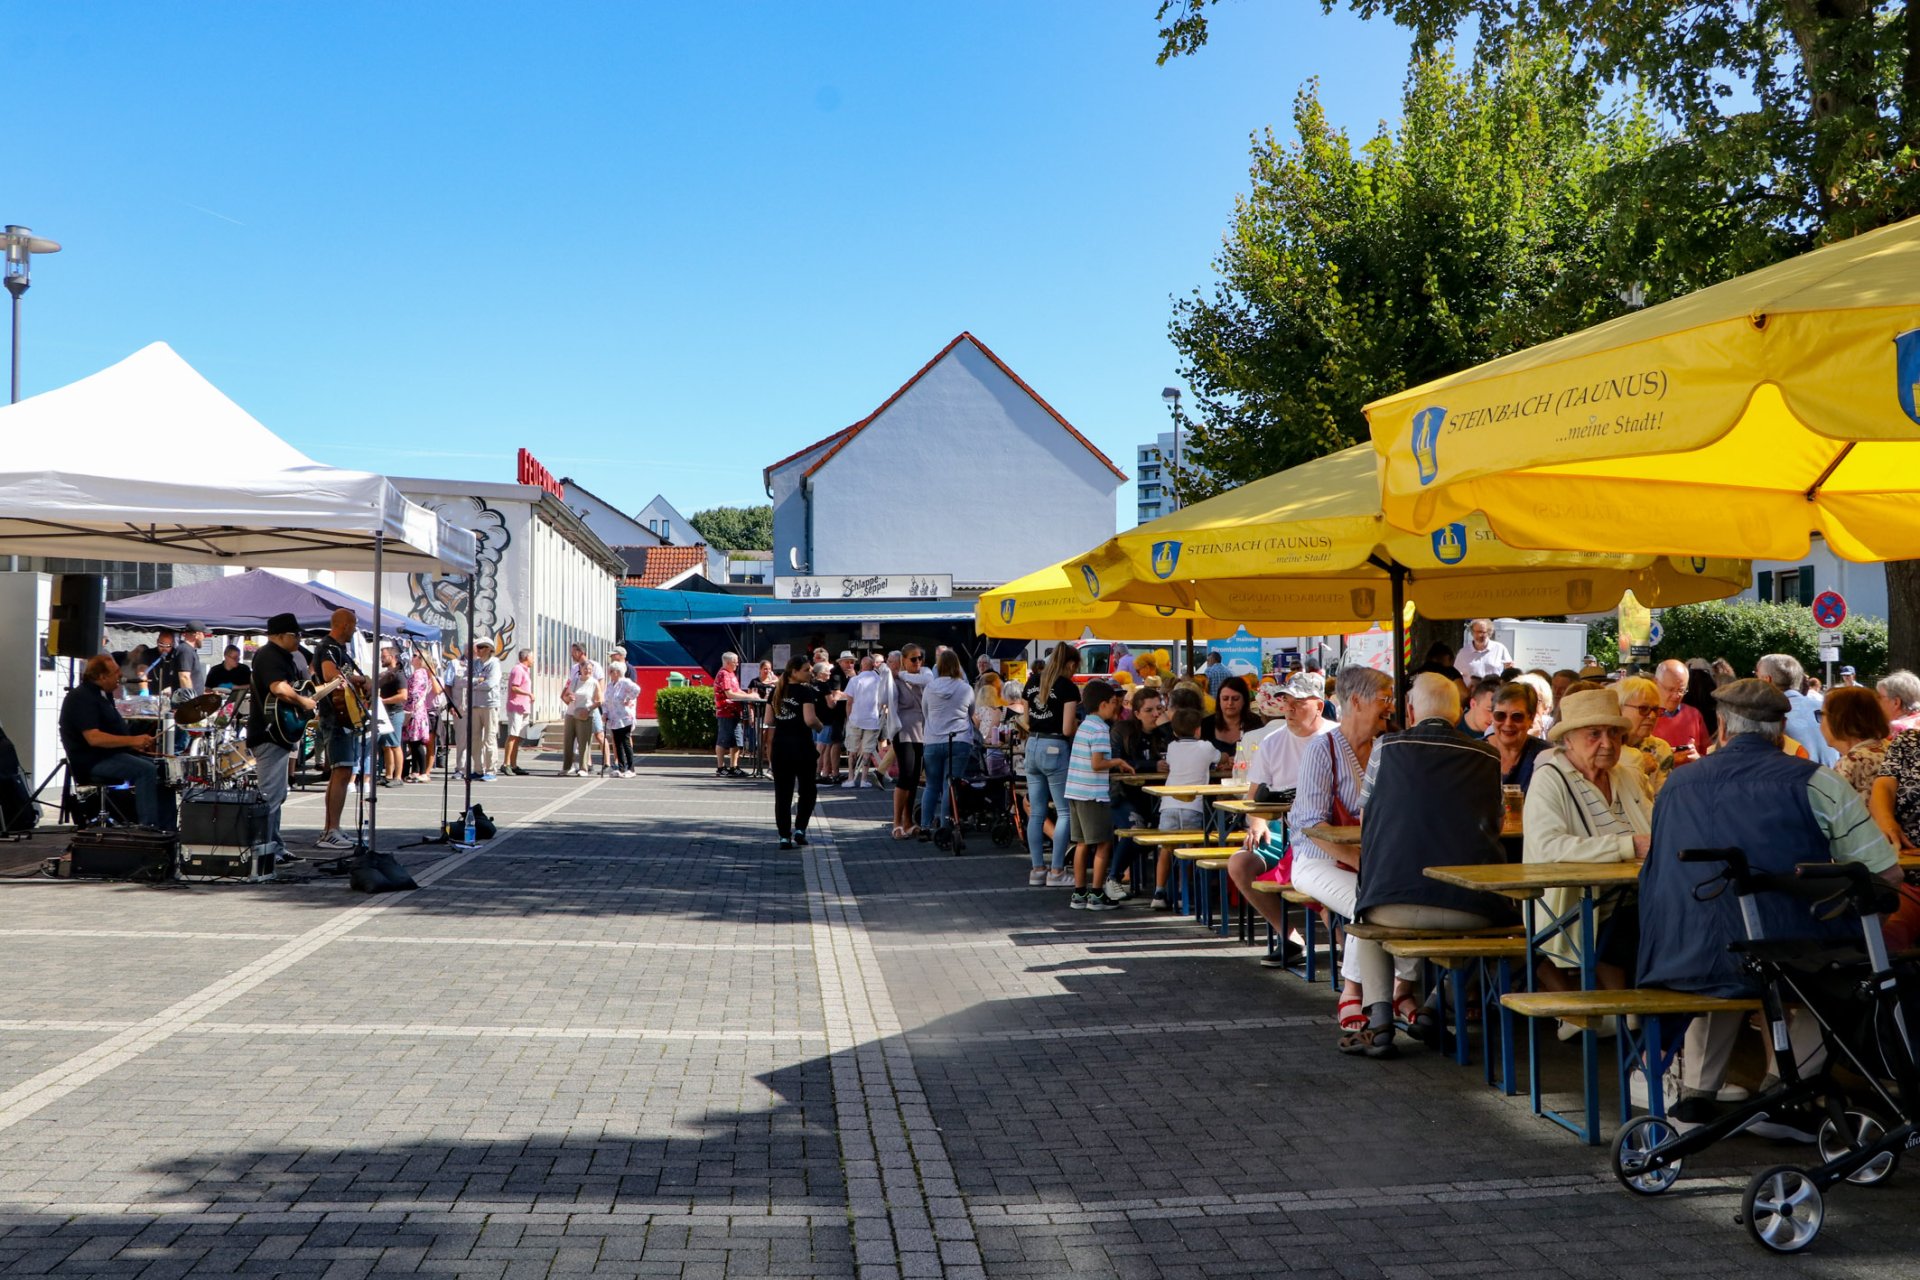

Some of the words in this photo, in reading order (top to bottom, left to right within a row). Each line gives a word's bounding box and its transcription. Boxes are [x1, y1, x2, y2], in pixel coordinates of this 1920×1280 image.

[1447, 392, 1553, 435] STEINBACH
[1555, 370, 1668, 416] (TAUNUS)
[1555, 417, 1610, 442] ...meine
[1613, 412, 1664, 434] Stadt!
[1187, 539, 1261, 556] STEINBACH
[1264, 536, 1332, 551] (TAUNUS)
[1303, 553, 1331, 563] Stadt!
